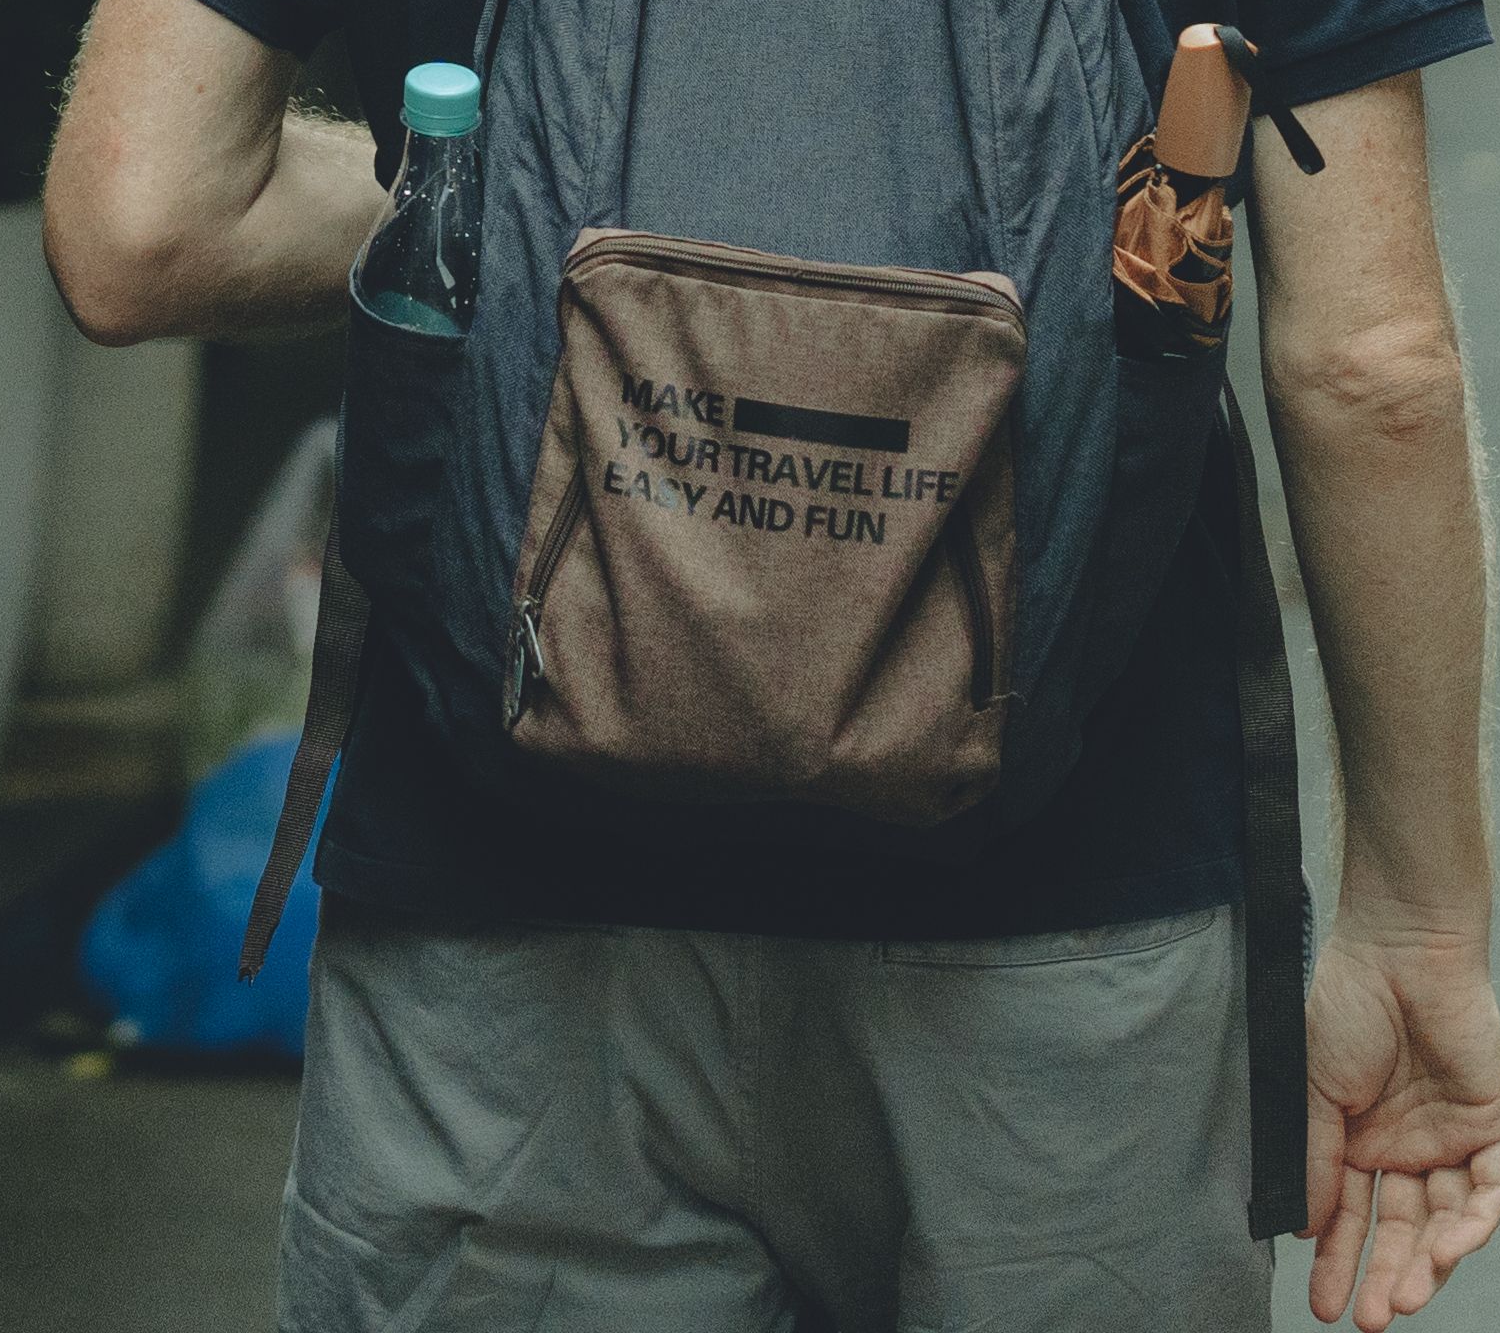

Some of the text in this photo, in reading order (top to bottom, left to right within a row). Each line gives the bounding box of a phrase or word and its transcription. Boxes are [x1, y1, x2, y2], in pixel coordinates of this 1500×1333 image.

[621, 373, 726, 427] MAKE
[617, 416, 961, 503] YOUR TRAVEL LIFE
[603, 460, 887, 546] EASY AND FUN
